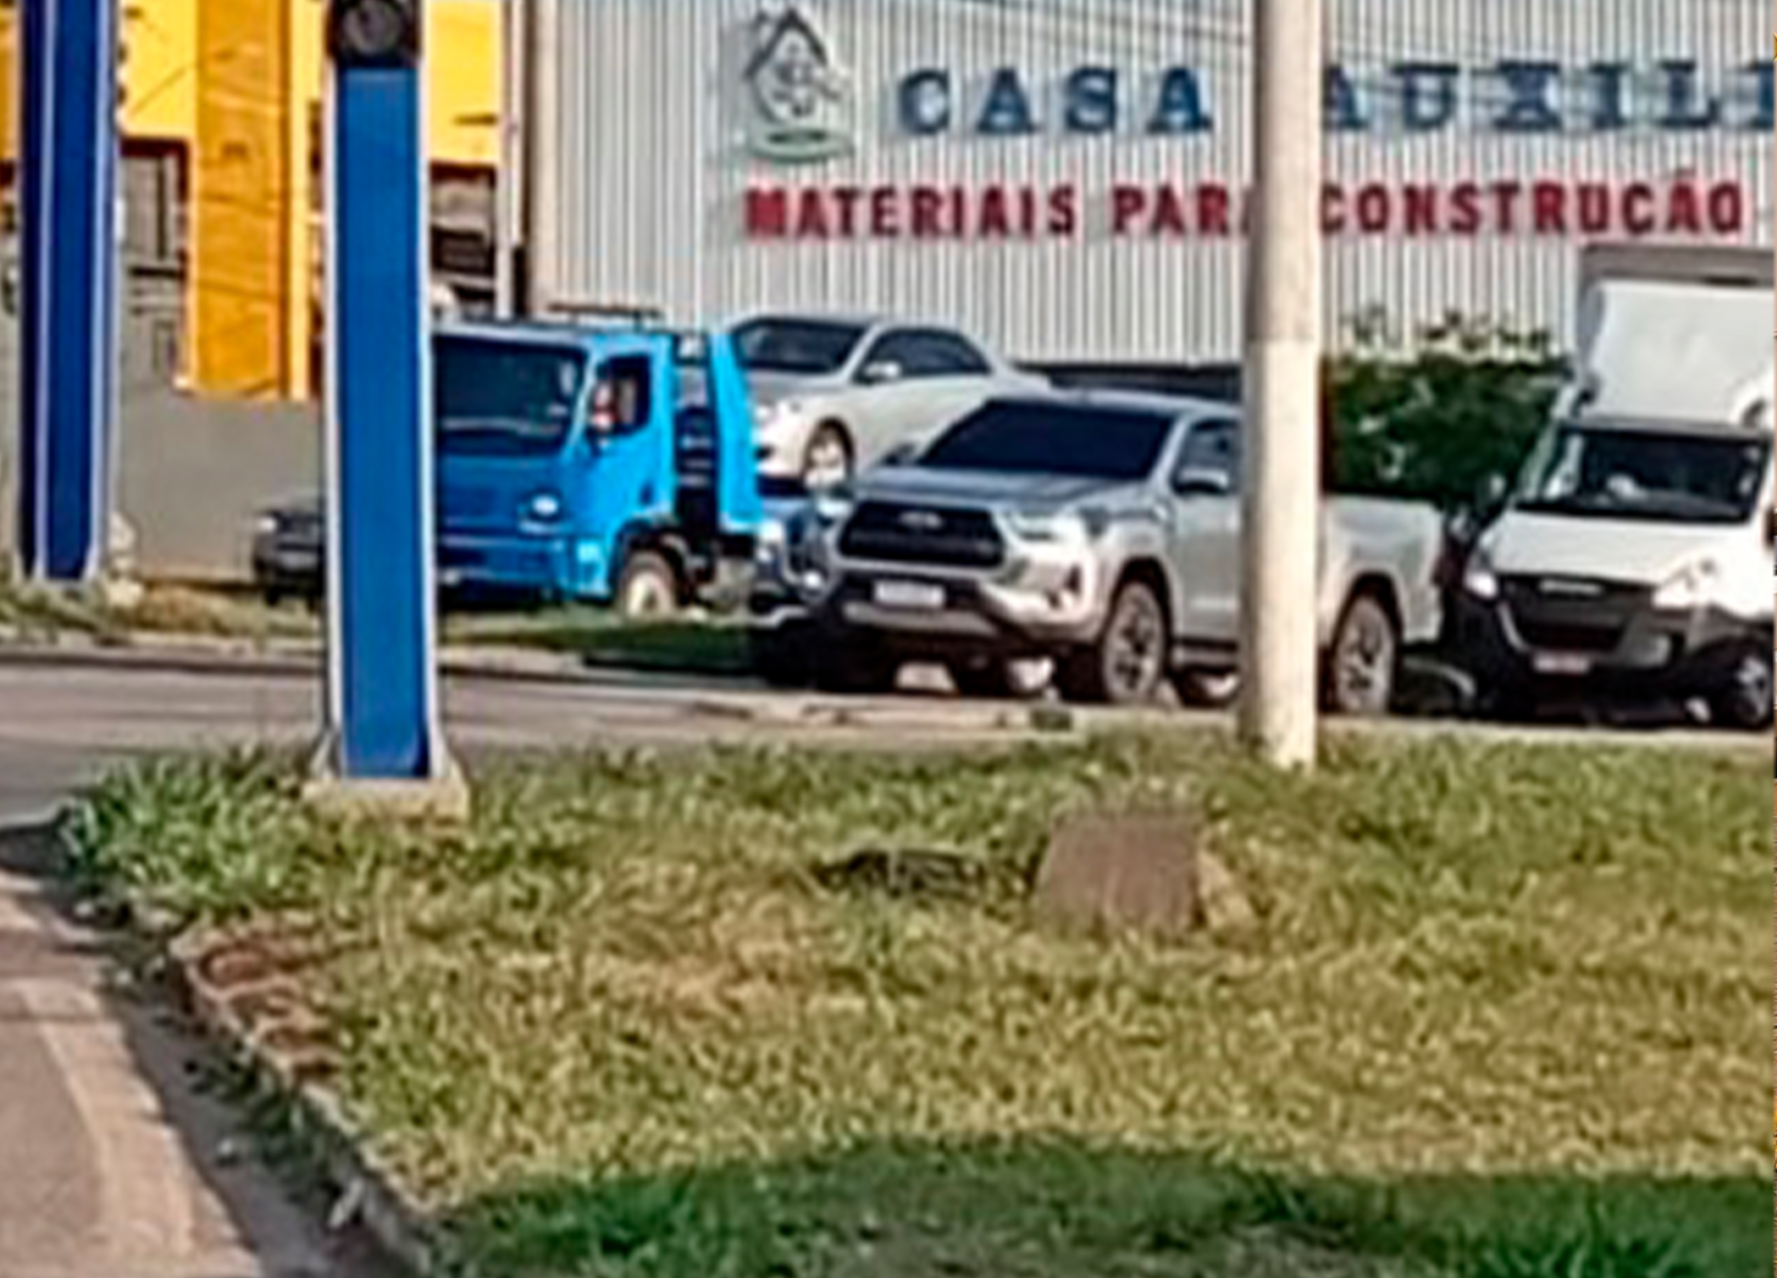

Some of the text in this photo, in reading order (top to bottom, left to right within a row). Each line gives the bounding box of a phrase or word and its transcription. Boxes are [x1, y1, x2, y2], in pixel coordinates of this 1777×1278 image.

[897, 66, 1211, 136] CASA
[744, 184, 1077, 240] MATERIAIS
[1110, 184, 1259, 240] PAR
